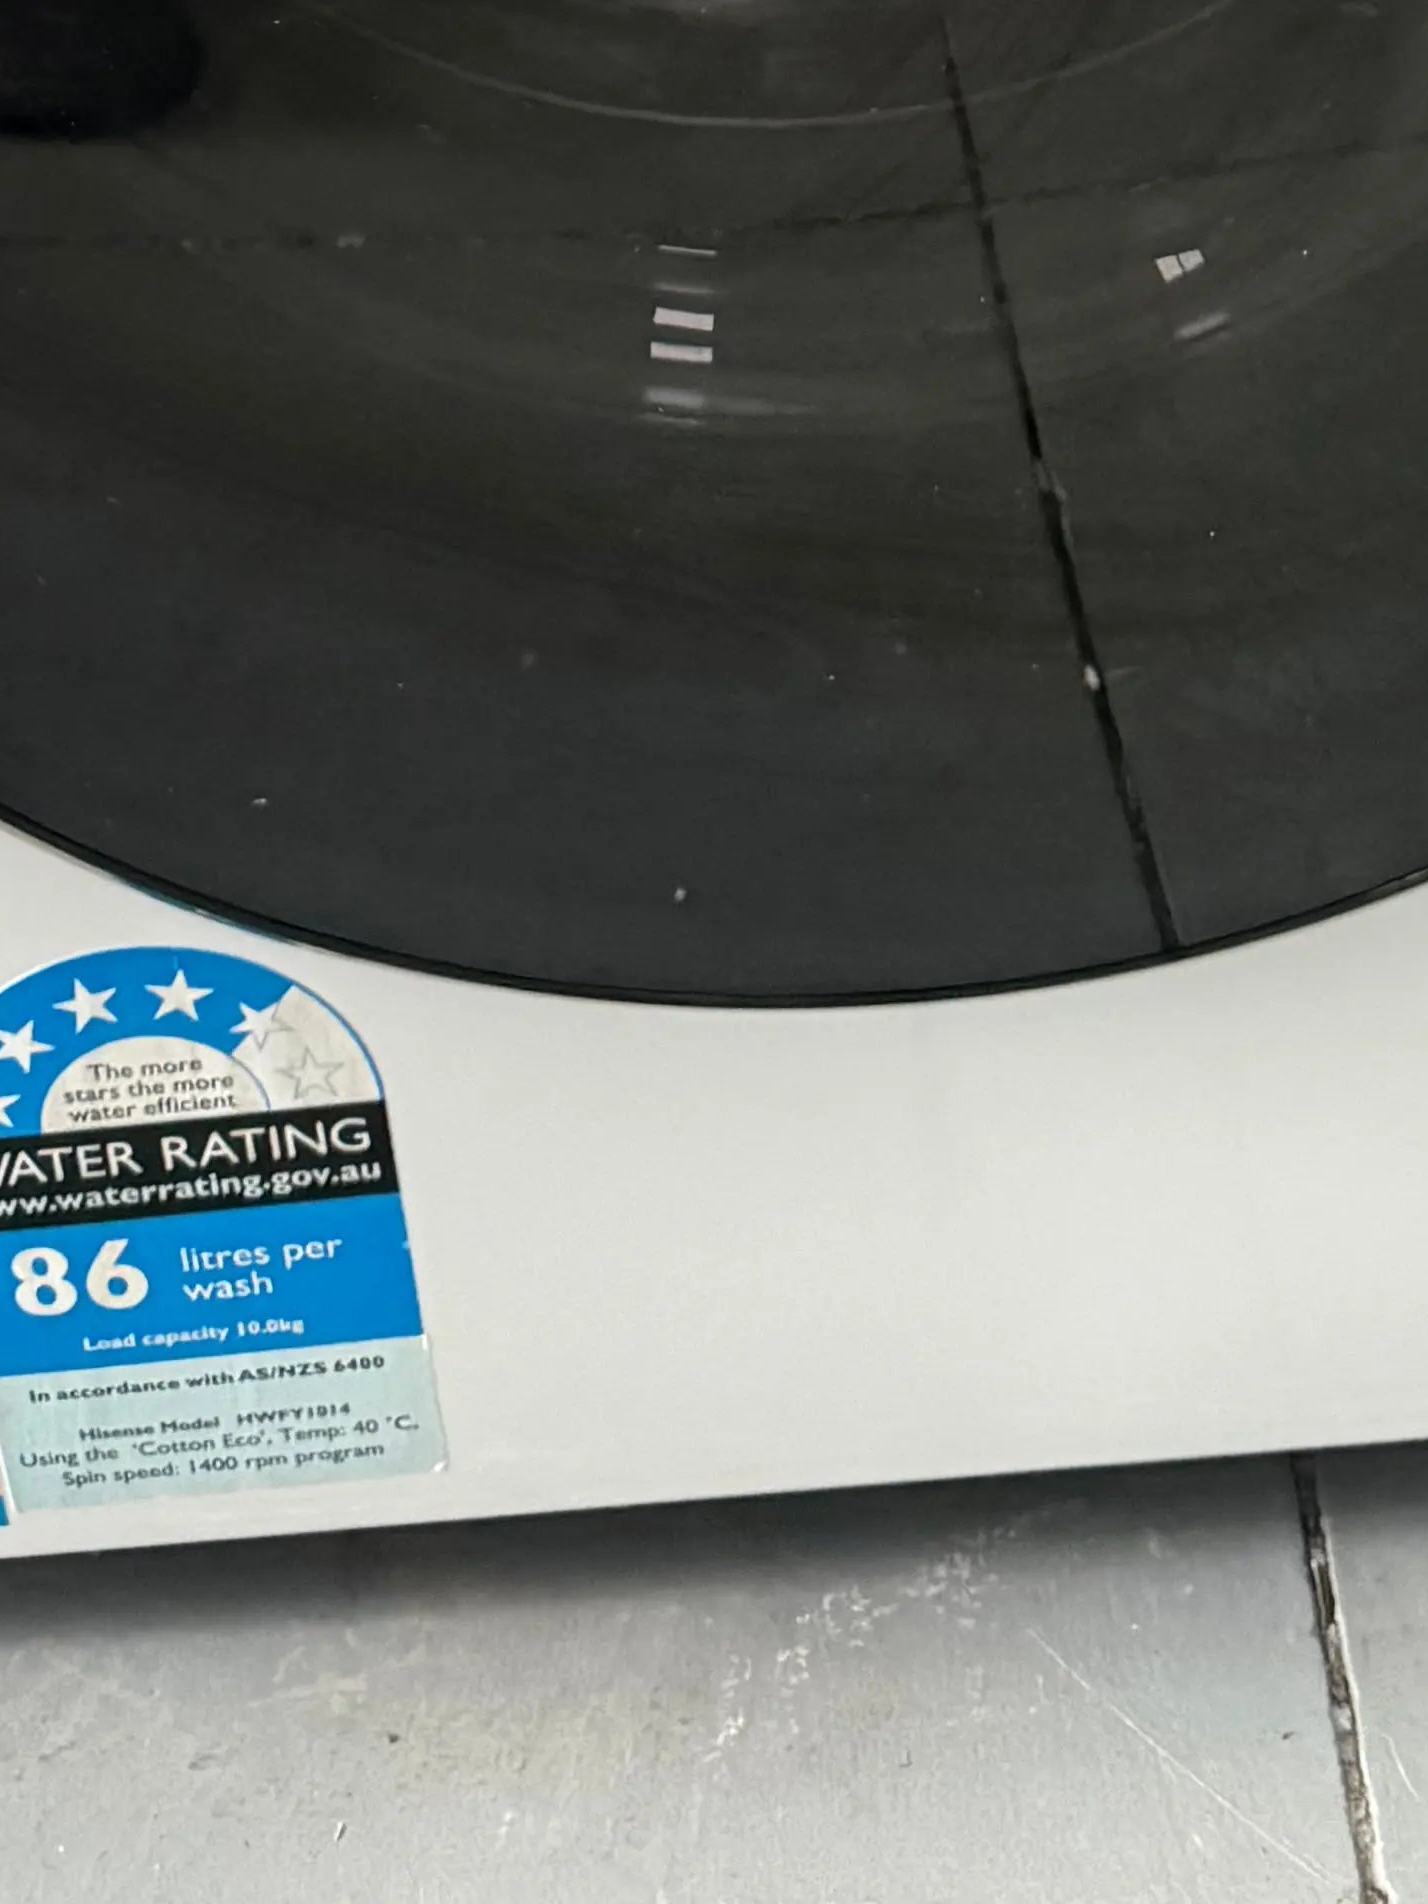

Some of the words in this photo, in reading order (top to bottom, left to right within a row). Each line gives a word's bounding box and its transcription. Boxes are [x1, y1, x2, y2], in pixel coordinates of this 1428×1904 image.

[86, 1063, 134, 1081] The
[141, 1058, 202, 1075] more
[63, 1086, 121, 1104] stars
[128, 1082, 169, 1098] the
[173, 1075, 234, 1093] more
[70, 1102, 136, 1123] water
[144, 1093, 237, 1116] efficient
[161, 1117, 372, 1172] RATING
[10, 1238, 149, 1317] 86
[179, 1243, 270, 1273] litres
[282, 1236, 343, 1271] per
[182, 1271, 274, 1302] wash
[83, 1333, 136, 1352] Load
[142, 1326, 229, 1349] capacity
[236, 1317, 305, 1337] 10.0kg
[29, 1389, 50, 1404] In
[56, 1377, 180, 1402] accordance
[185, 1371, 234, 1388] with
[237, 1360, 328, 1384] AS/NZS
[333, 1354, 386, 1375] 6400
[19, 1450, 78, 1469] Using
[85, 1445, 119, 1461] the
[281, 1424, 348, 1446] Temp:
[353, 1418, 379, 1434] 40
[79, 1422, 155, 1442] Hisense
[160, 1416, 221, 1434] Model
[62, 1470, 107, 1487] Spin
[113, 1461, 181, 1484] speed:
[189, 1455, 238, 1473] 1400
[244, 1452, 289, 1471] rpm
[294, 1443, 385, 1467] program
